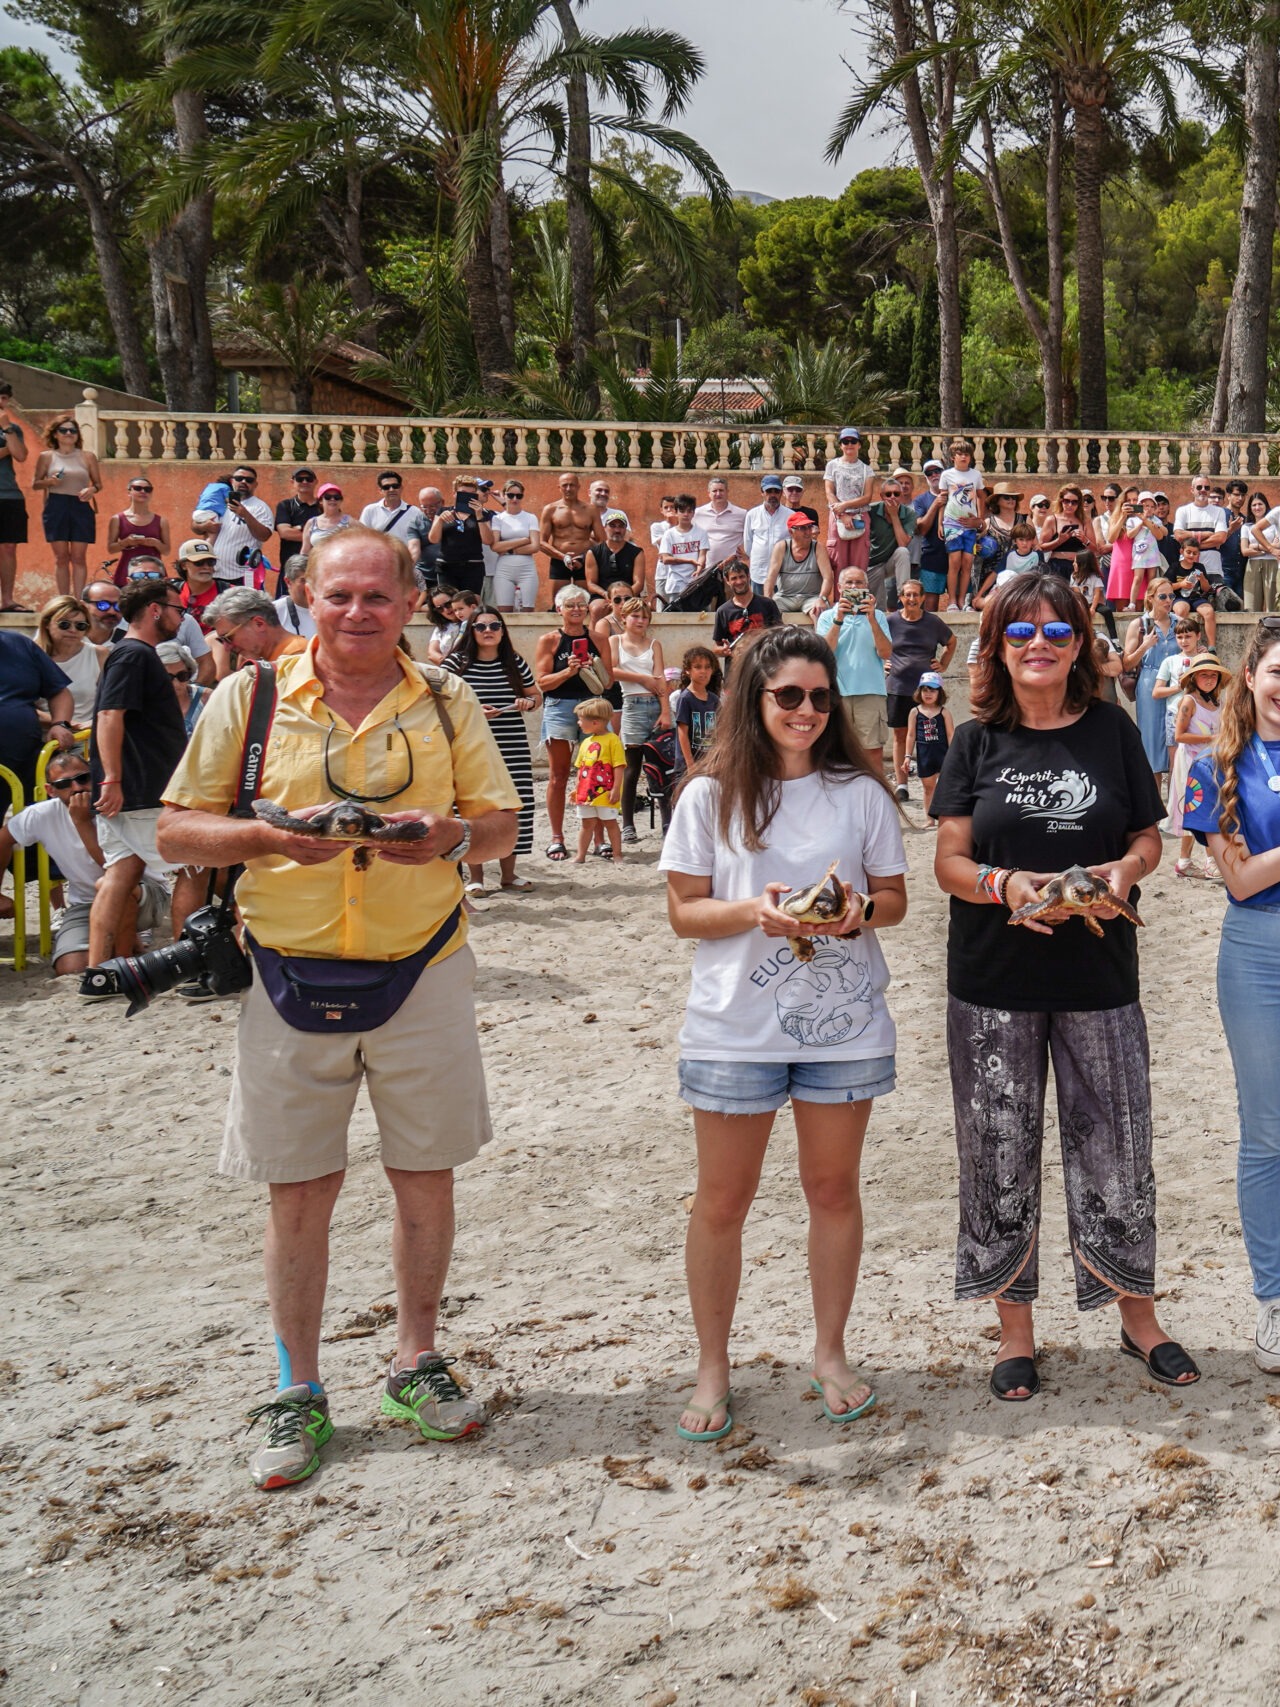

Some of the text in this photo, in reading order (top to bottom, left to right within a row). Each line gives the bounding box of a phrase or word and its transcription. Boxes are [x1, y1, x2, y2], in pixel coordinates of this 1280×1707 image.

[243, 742, 263, 791] Canon
[1014, 784, 1036, 793] de la
[1005, 789, 1051, 808] mar
[1046, 820, 1059, 831] 20
